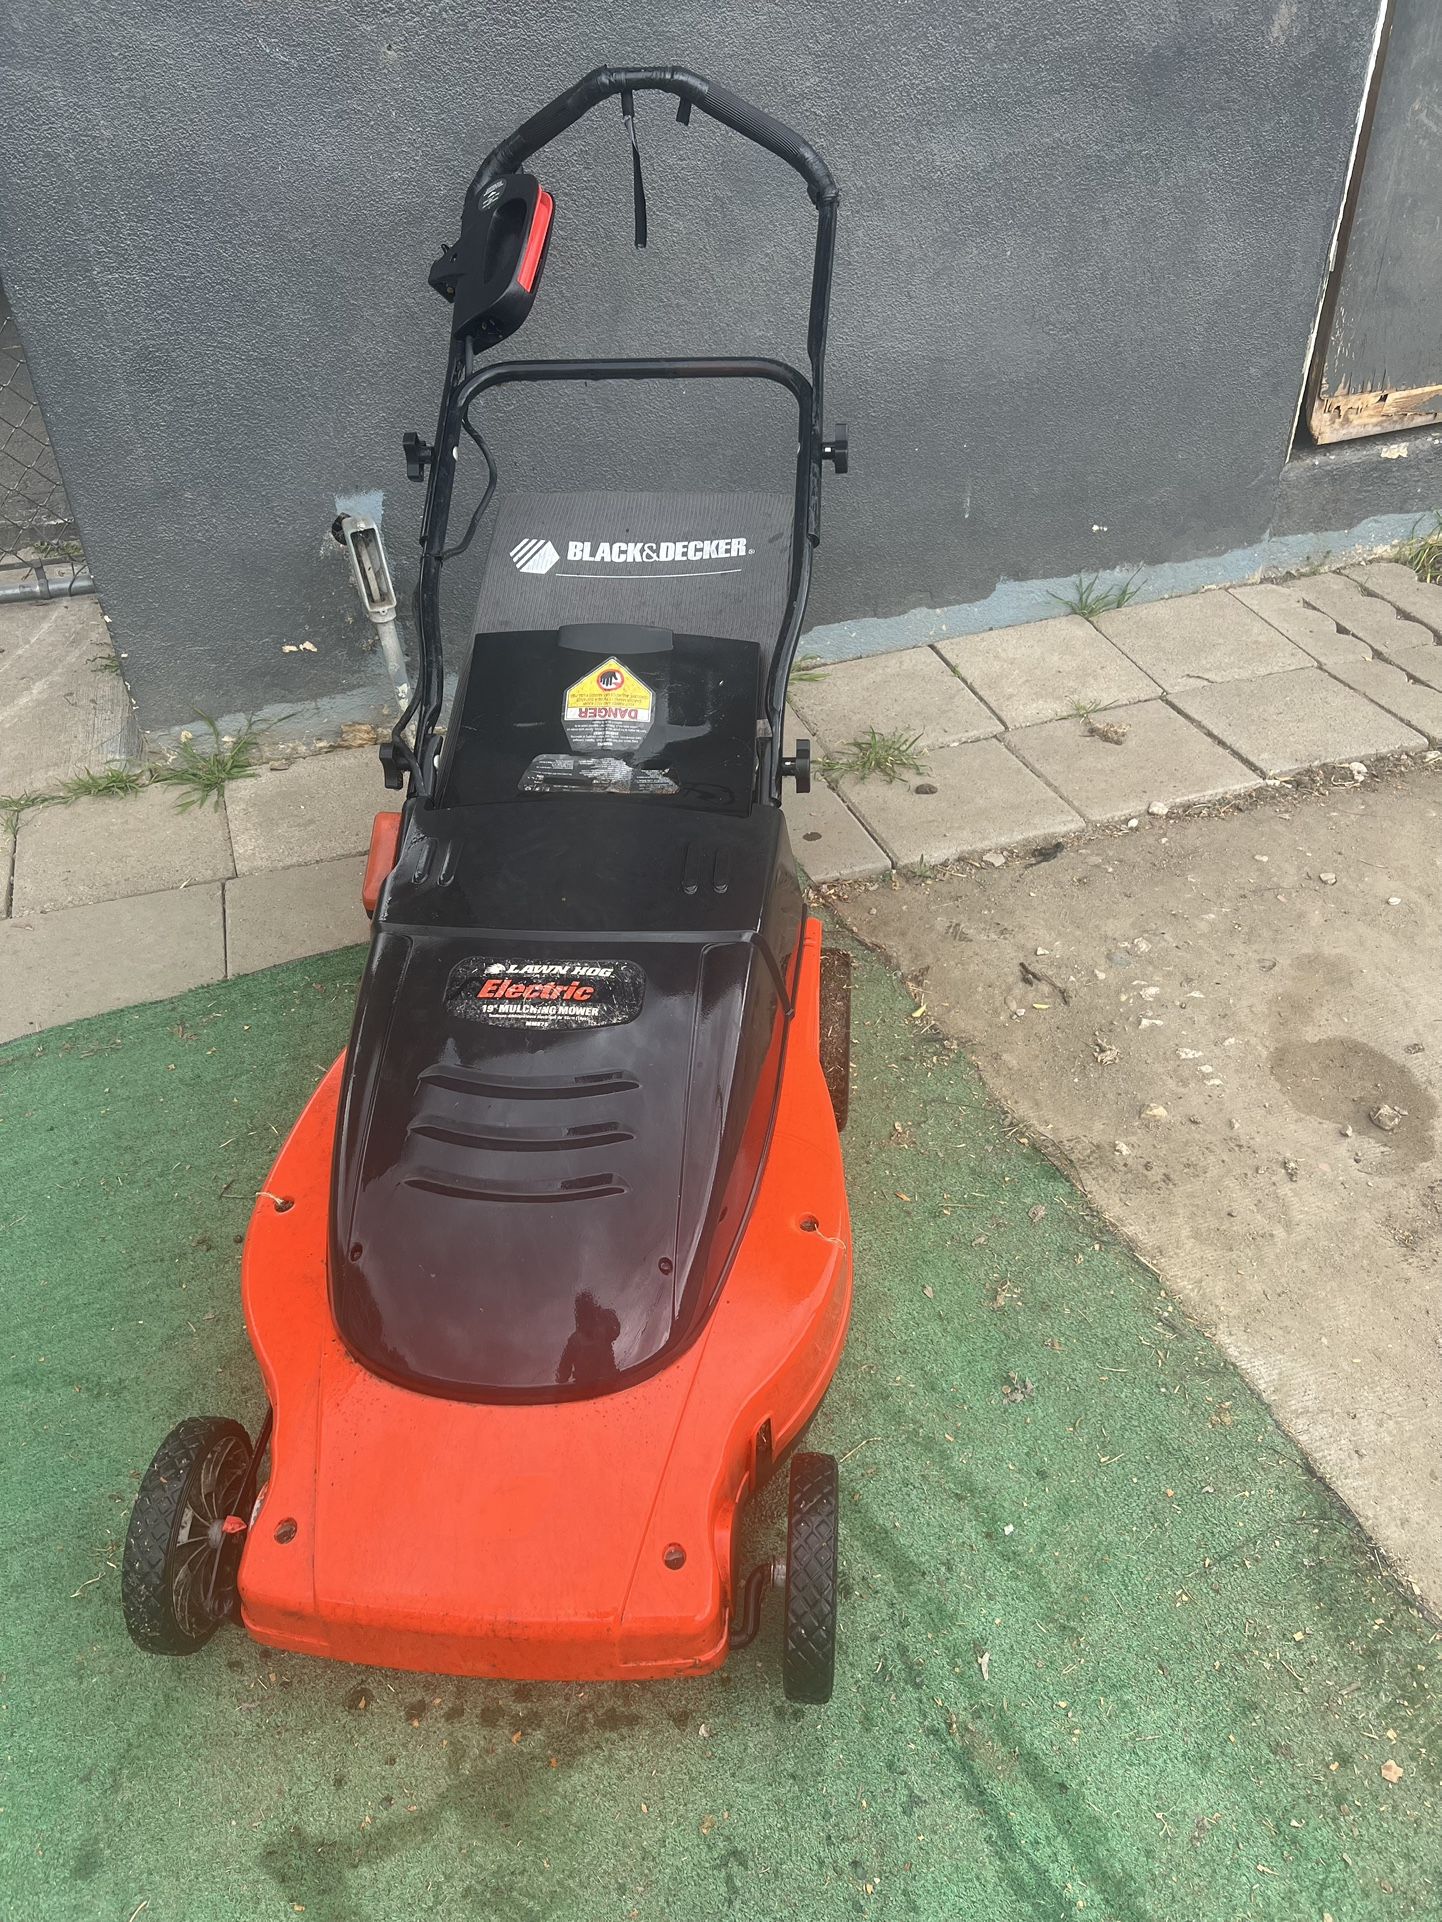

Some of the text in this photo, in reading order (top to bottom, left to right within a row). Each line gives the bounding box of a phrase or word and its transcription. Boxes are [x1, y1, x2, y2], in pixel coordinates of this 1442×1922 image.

[567, 538, 747, 563] BLACK&DECKER
[578, 707, 638, 720] DANGER
[505, 964, 614, 977] LAWN HOG
[477, 979, 595, 1001] Electric
[498, 1004, 557, 1014] MULCHING
[557, 1006, 600, 1016] MOWER
